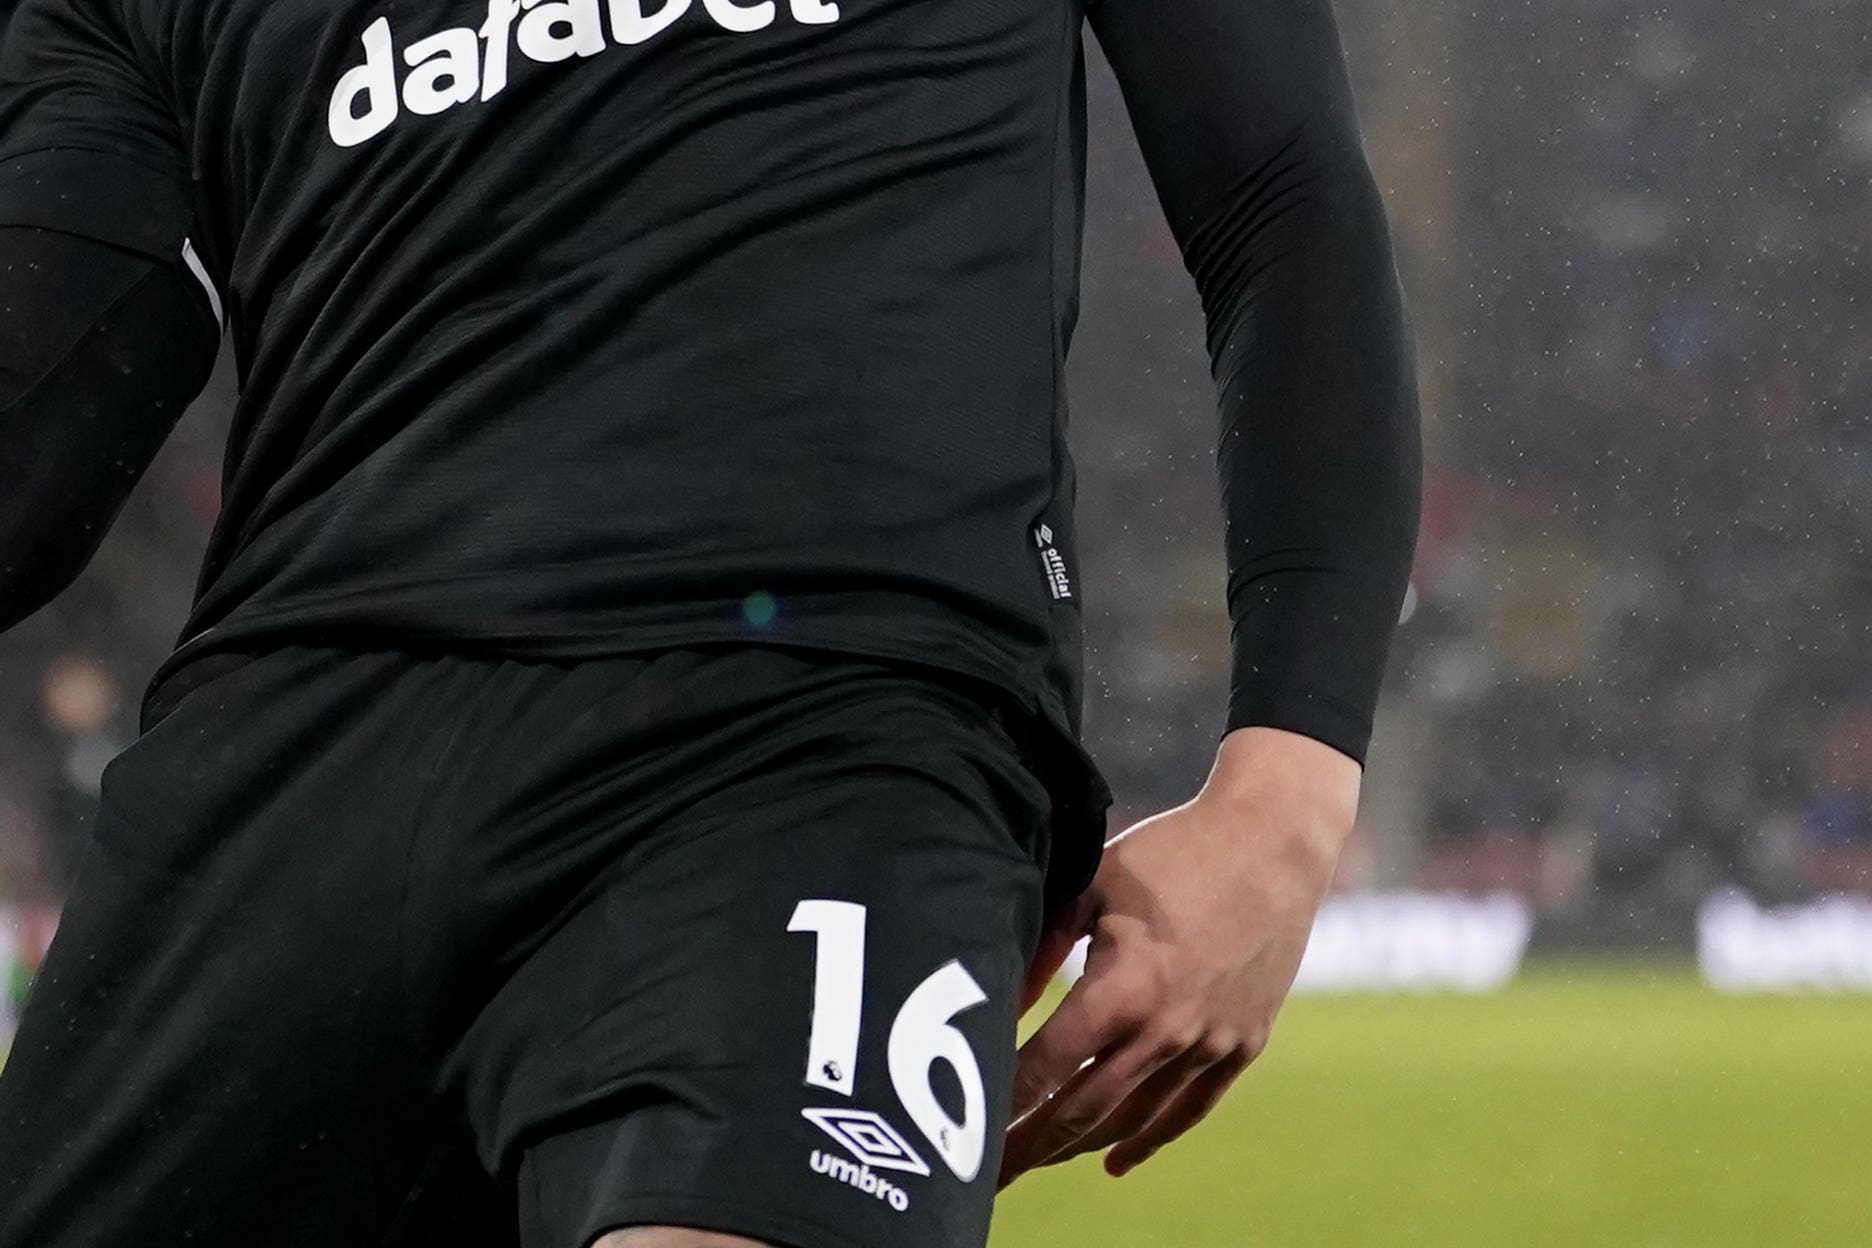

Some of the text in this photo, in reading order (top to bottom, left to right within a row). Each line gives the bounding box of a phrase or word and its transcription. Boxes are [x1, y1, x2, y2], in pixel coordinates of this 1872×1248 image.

[1047, 548, 1073, 598] official
[785, 899, 989, 1184] 16
[809, 1149, 910, 1212] umbro
